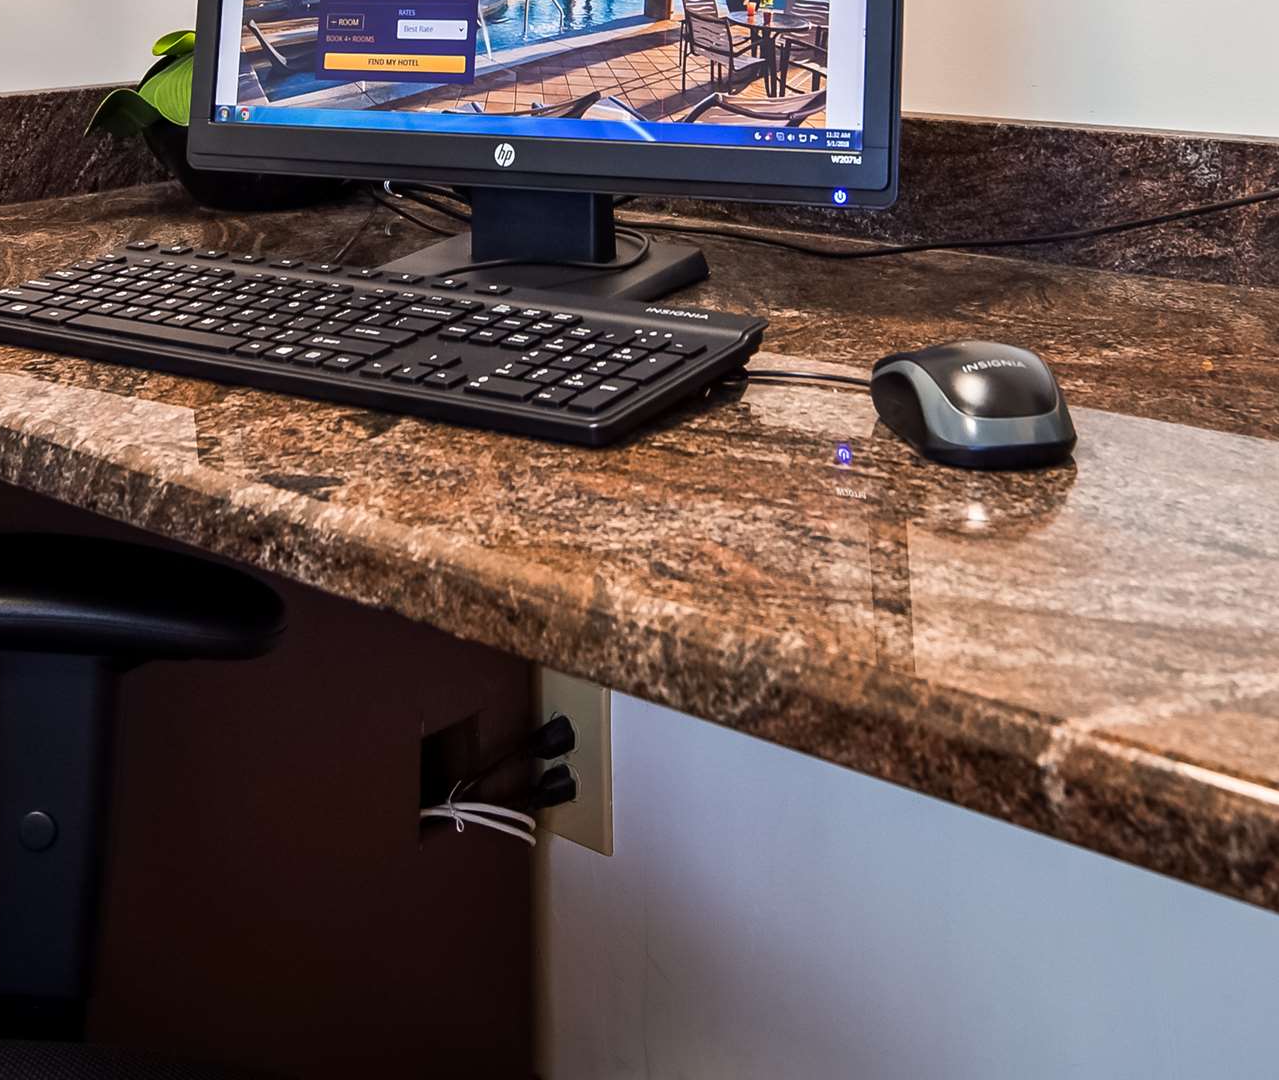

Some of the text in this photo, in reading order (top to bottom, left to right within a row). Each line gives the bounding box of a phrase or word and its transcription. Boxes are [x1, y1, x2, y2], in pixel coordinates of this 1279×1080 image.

[338, 18, 359, 26] ROOM
[403, 25, 434, 33] Best Rate
[368, 58, 419, 67] FIND MY HOTEL
[494, 143, 515, 167] hp
[645, 307, 709, 320] INSIGNIA
[962, 359, 1026, 373] INSIGNIA
